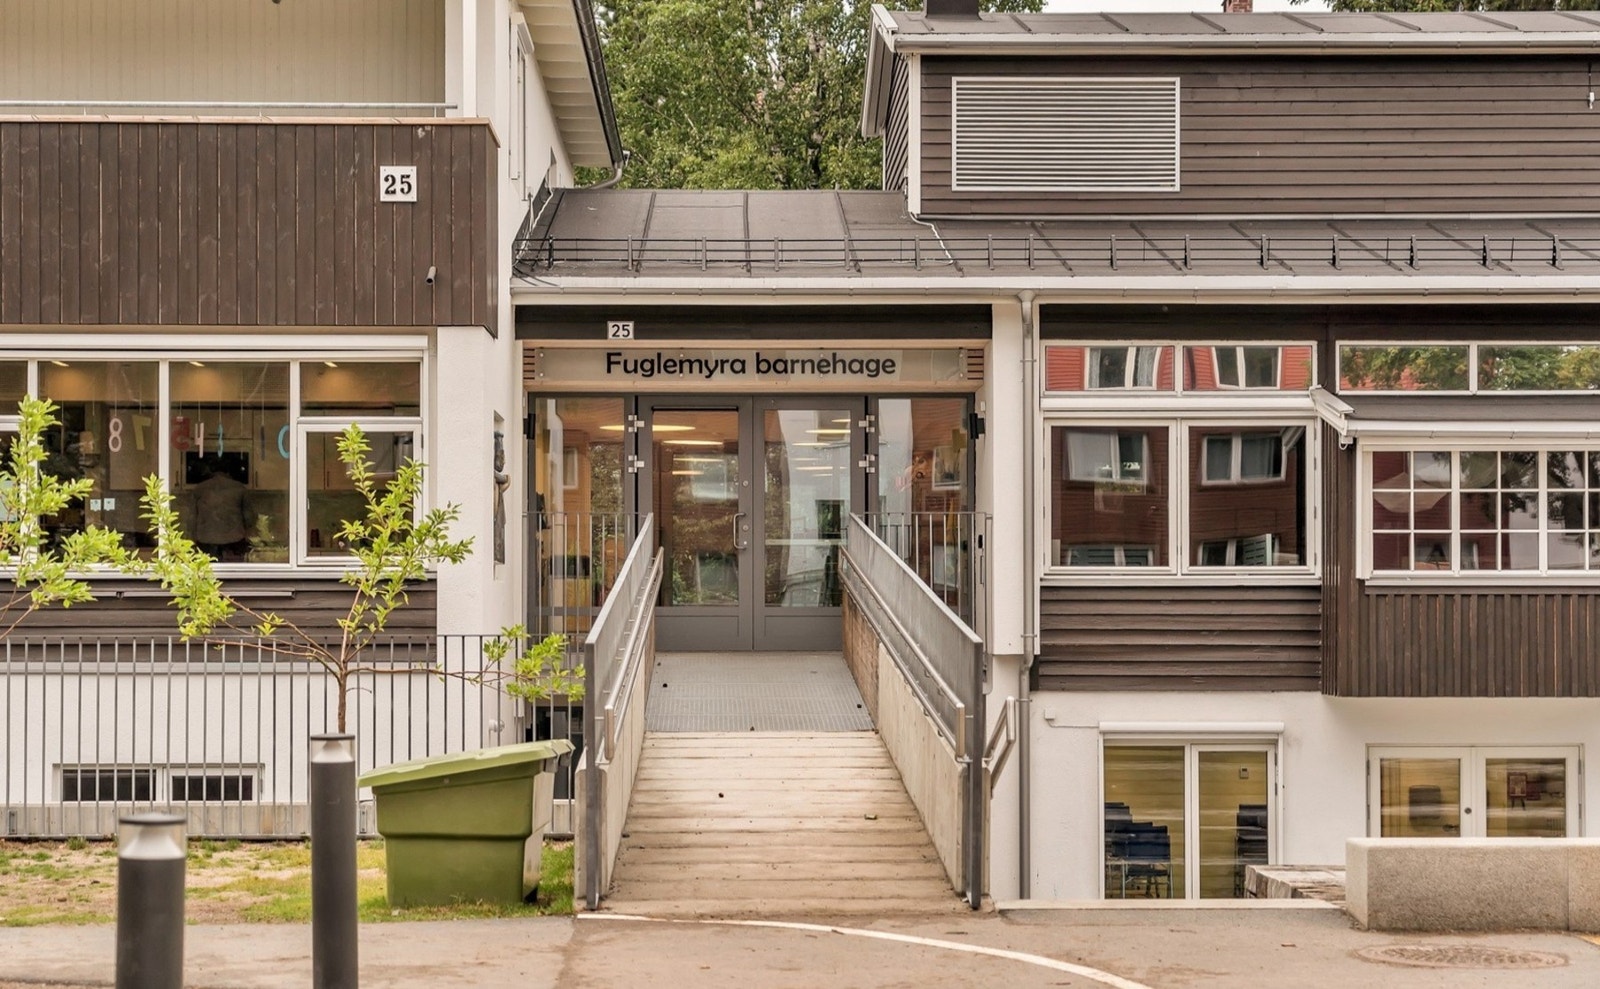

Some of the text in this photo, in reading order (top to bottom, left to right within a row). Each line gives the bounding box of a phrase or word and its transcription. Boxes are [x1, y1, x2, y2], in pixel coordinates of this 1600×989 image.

[384, 174, 412, 194] 25
[611, 324, 631, 337] 25
[606, 352, 896, 378] Fuglemyra barnehage
[108, 418, 122, 452] 8
